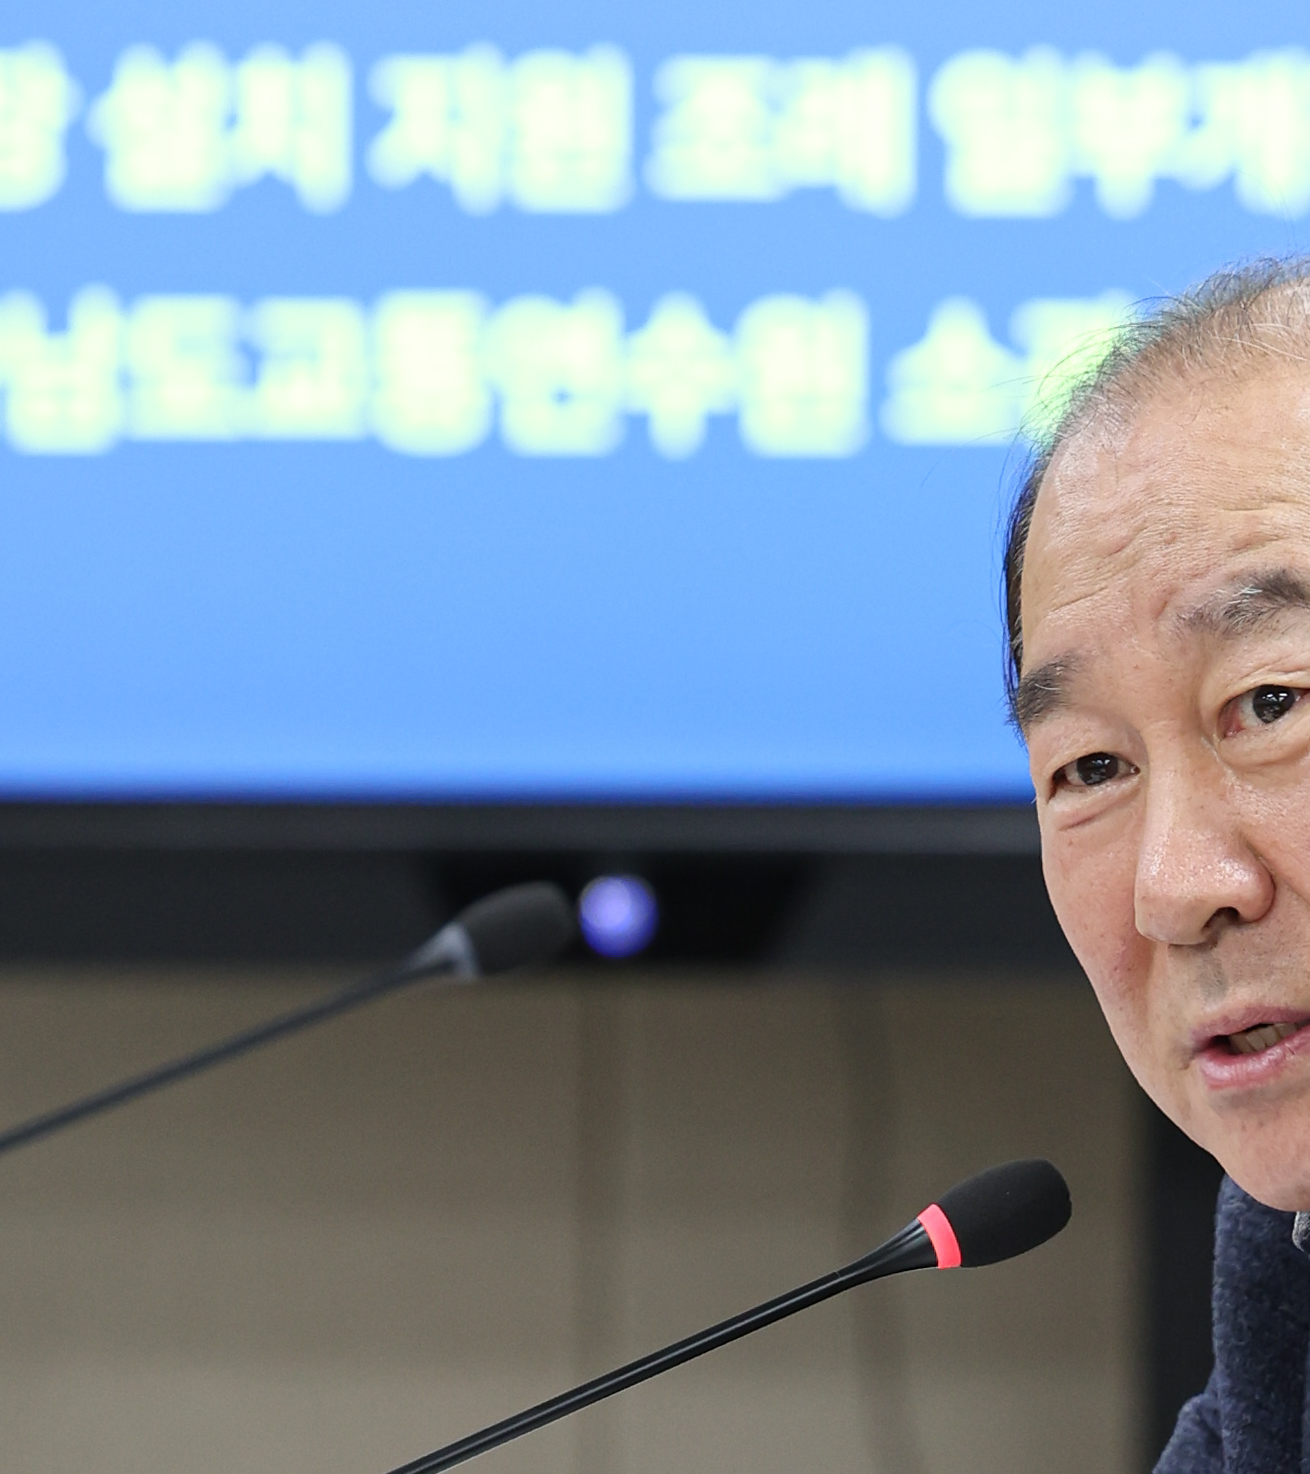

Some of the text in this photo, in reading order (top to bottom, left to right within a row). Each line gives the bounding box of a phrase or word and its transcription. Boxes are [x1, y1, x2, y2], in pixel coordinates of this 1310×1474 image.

[90, 44, 352, 210] 설치
[371, 46, 632, 211] 지원
[649, 48, 917, 212] 조례
